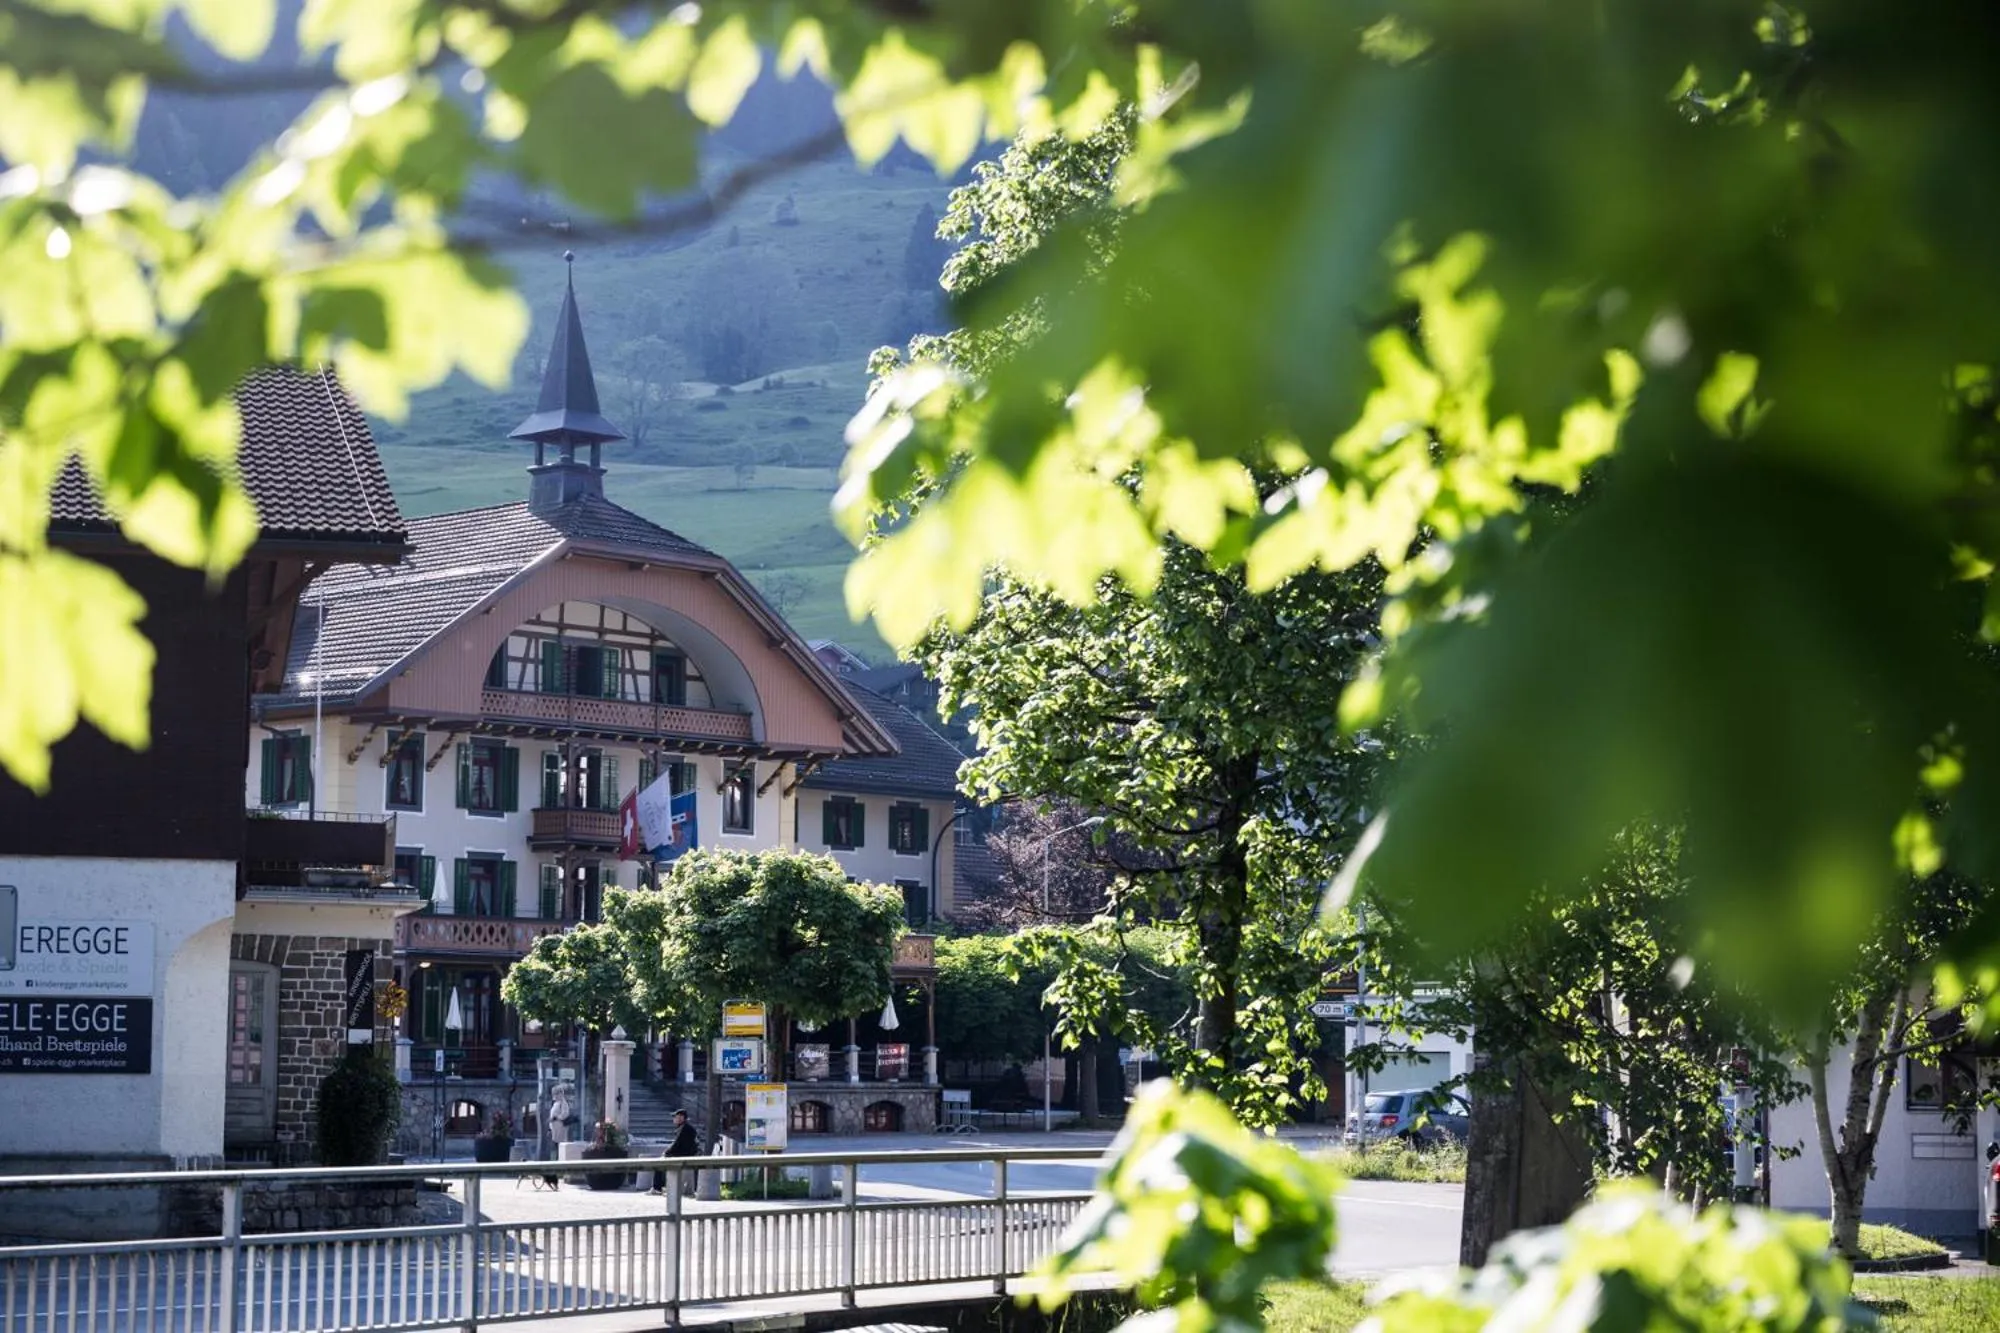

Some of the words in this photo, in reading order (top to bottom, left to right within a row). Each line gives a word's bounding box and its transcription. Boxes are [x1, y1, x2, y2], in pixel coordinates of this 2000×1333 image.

[19, 926, 129, 954] EREGGE
[77, 957, 128, 976] Spiele
[1318, 1005, 1331, 1013] 70
[46, 1035, 128, 1054] Brettspiele
